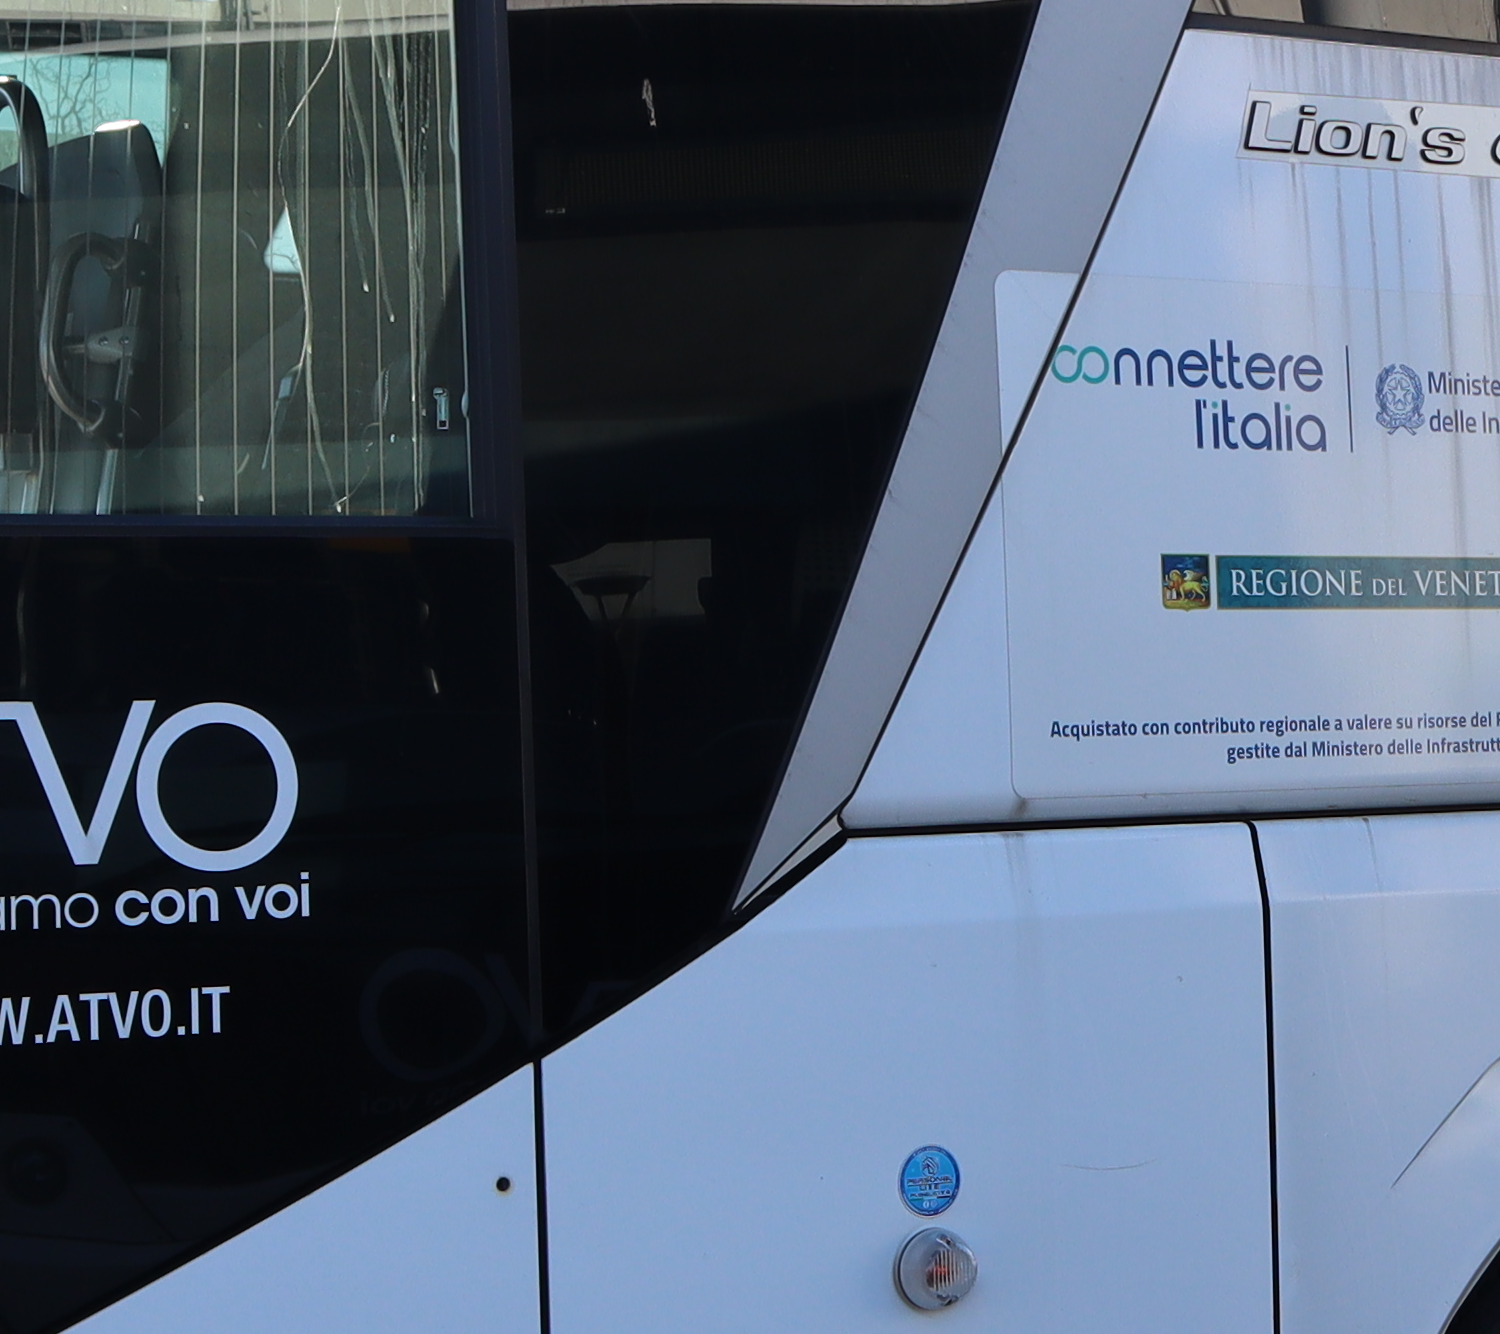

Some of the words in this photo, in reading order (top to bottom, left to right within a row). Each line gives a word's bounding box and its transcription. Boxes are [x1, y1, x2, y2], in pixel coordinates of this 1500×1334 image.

[1243, 100, 1467, 165] Lion's
[1051, 339, 1323, 392] connettere
[1429, 409, 1477, 433] delle
[1231, 569, 1364, 597] REGIONE
[1372, 578, 1408, 597] DEL
[1050, 721, 1137, 741] Acquistato
[1142, 721, 1170, 735] con
[1174, 717, 1255, 735] contributo
[1259, 716, 1330, 737] regionale
[1334, 719, 1343, 731] a
[1346, 715, 1392, 730] valere
[1396, 718, 1412, 729] su
[1418, 712, 1467, 729] risorse
[1470, 712, 1492, 727] del
[1227, 743, 1280, 764] gestite
[1284, 742, 1307, 759] dal
[1312, 740, 1383, 758] Ministero
[1387, 738, 1423, 755] delle
[114, 886, 219, 927] con
[234, 871, 310, 921] voi
